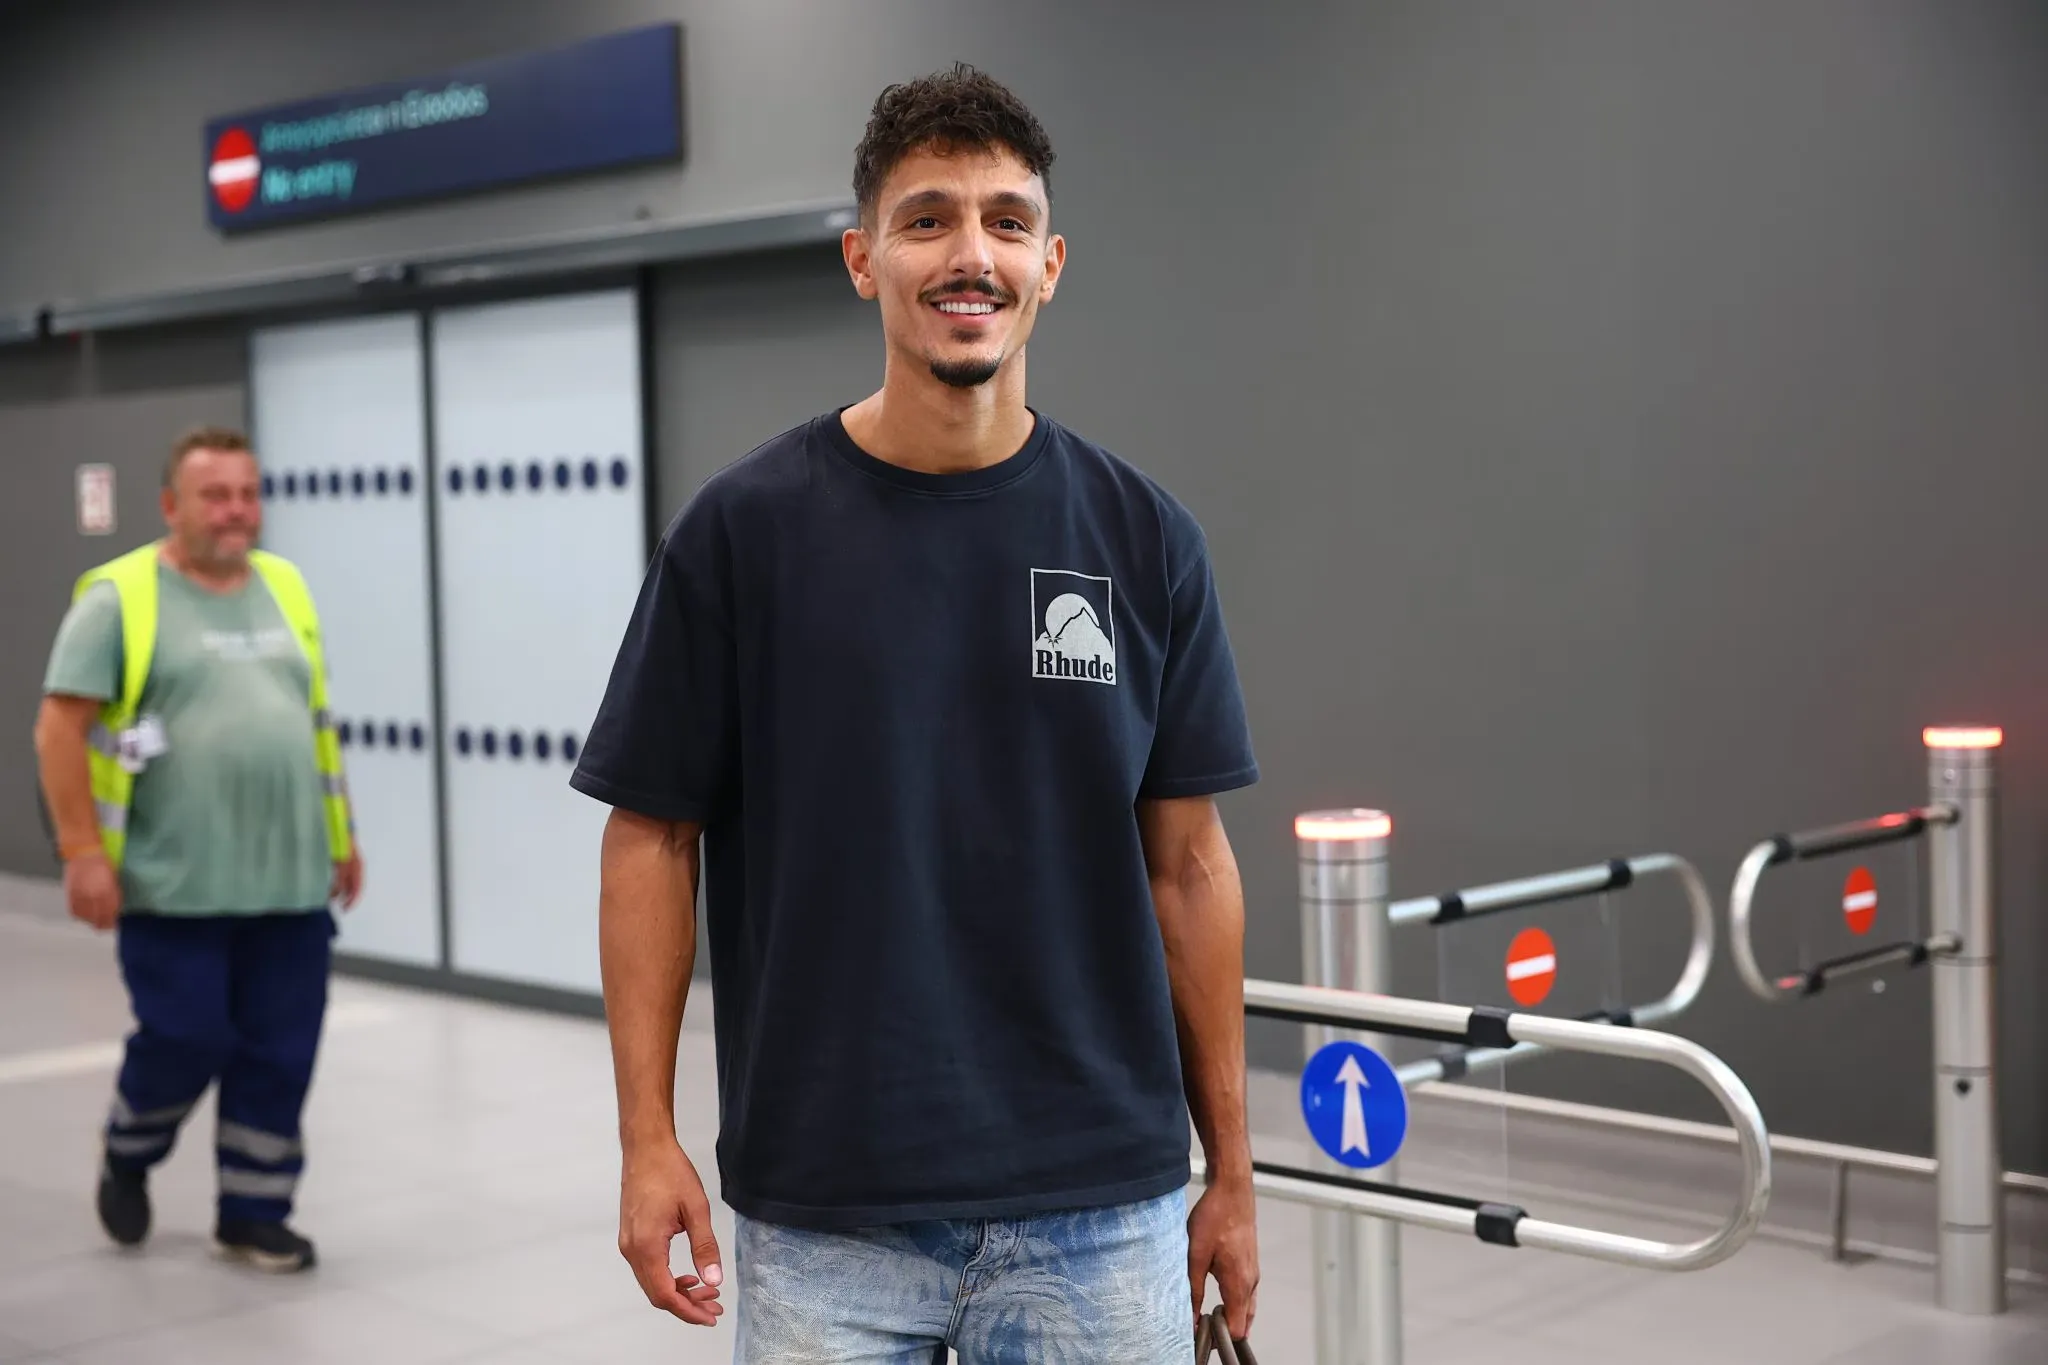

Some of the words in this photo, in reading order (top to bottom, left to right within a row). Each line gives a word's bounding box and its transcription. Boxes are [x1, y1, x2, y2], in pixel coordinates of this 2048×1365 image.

[263, 165, 293, 203] No
[296, 160, 357, 199] entry
[1035, 649, 1114, 681] Rhude
